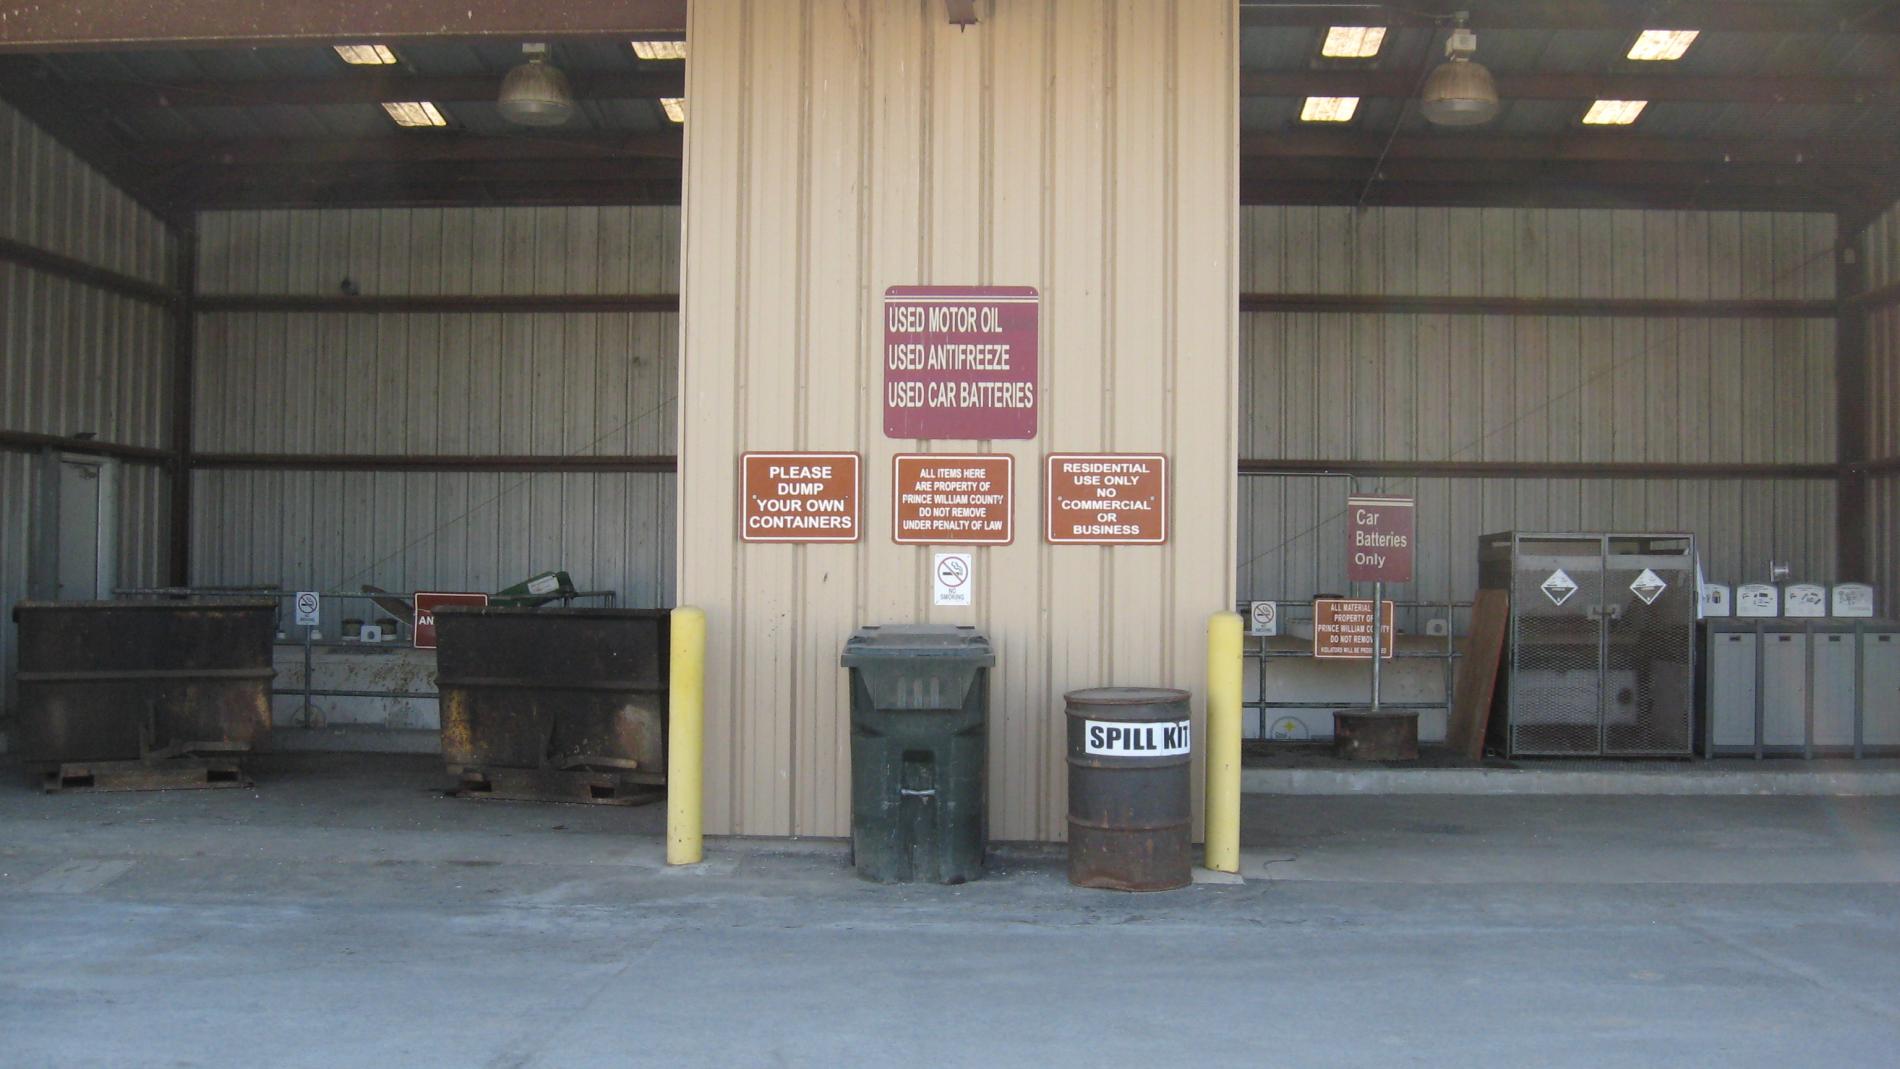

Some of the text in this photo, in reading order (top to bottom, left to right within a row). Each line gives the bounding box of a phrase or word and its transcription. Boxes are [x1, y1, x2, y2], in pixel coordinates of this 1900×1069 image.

[889, 307, 1003, 333] USED MOTOR OIL
[888, 344, 1010, 370] USED ANTIFREEZE
[888, 382, 1034, 408] USED CAR BATTERIES
[769, 466, 832, 479] PLEASE
[920, 468, 986, 478] ALL ITEMS HERE
[1063, 463, 1150, 473] RESIDENTIAL
[1074, 475, 1139, 485] USE ONLY
[777, 483, 824, 495] DUMP
[915, 481, 991, 491] ARE PROPERTY OF
[1096, 488, 1116, 497] NO
[902, 494, 1004, 504] PRINCE WILLIAM COUNTY
[756, 499, 845, 512] YOUR OWN
[1061, 500, 1151, 510] COMMERCIAL
[919, 507, 986, 517] DO NOT REMOVE
[1356, 509, 1379, 525] Car
[749, 516, 852, 529] CONTAINERS
[1097, 513, 1117, 522] OR
[903, 520, 1003, 530] UNDER PENALTY OF LAW
[1072, 525, 1140, 535] BUSINESS
[1356, 530, 1407, 547] Batteries
[1355, 552, 1386, 568] Only
[1331, 603, 1341, 611] ALL
[1334, 614, 1365, 622] PROPERTY
[1317, 625, 1339, 633] PRINCE
[1341, 625, 1365, 633] WILLIAM
[1330, 635, 1339, 643] DO
[1340, 635, 1352, 643] NOT
[1090, 725, 1188, 750] SPILL KIT
